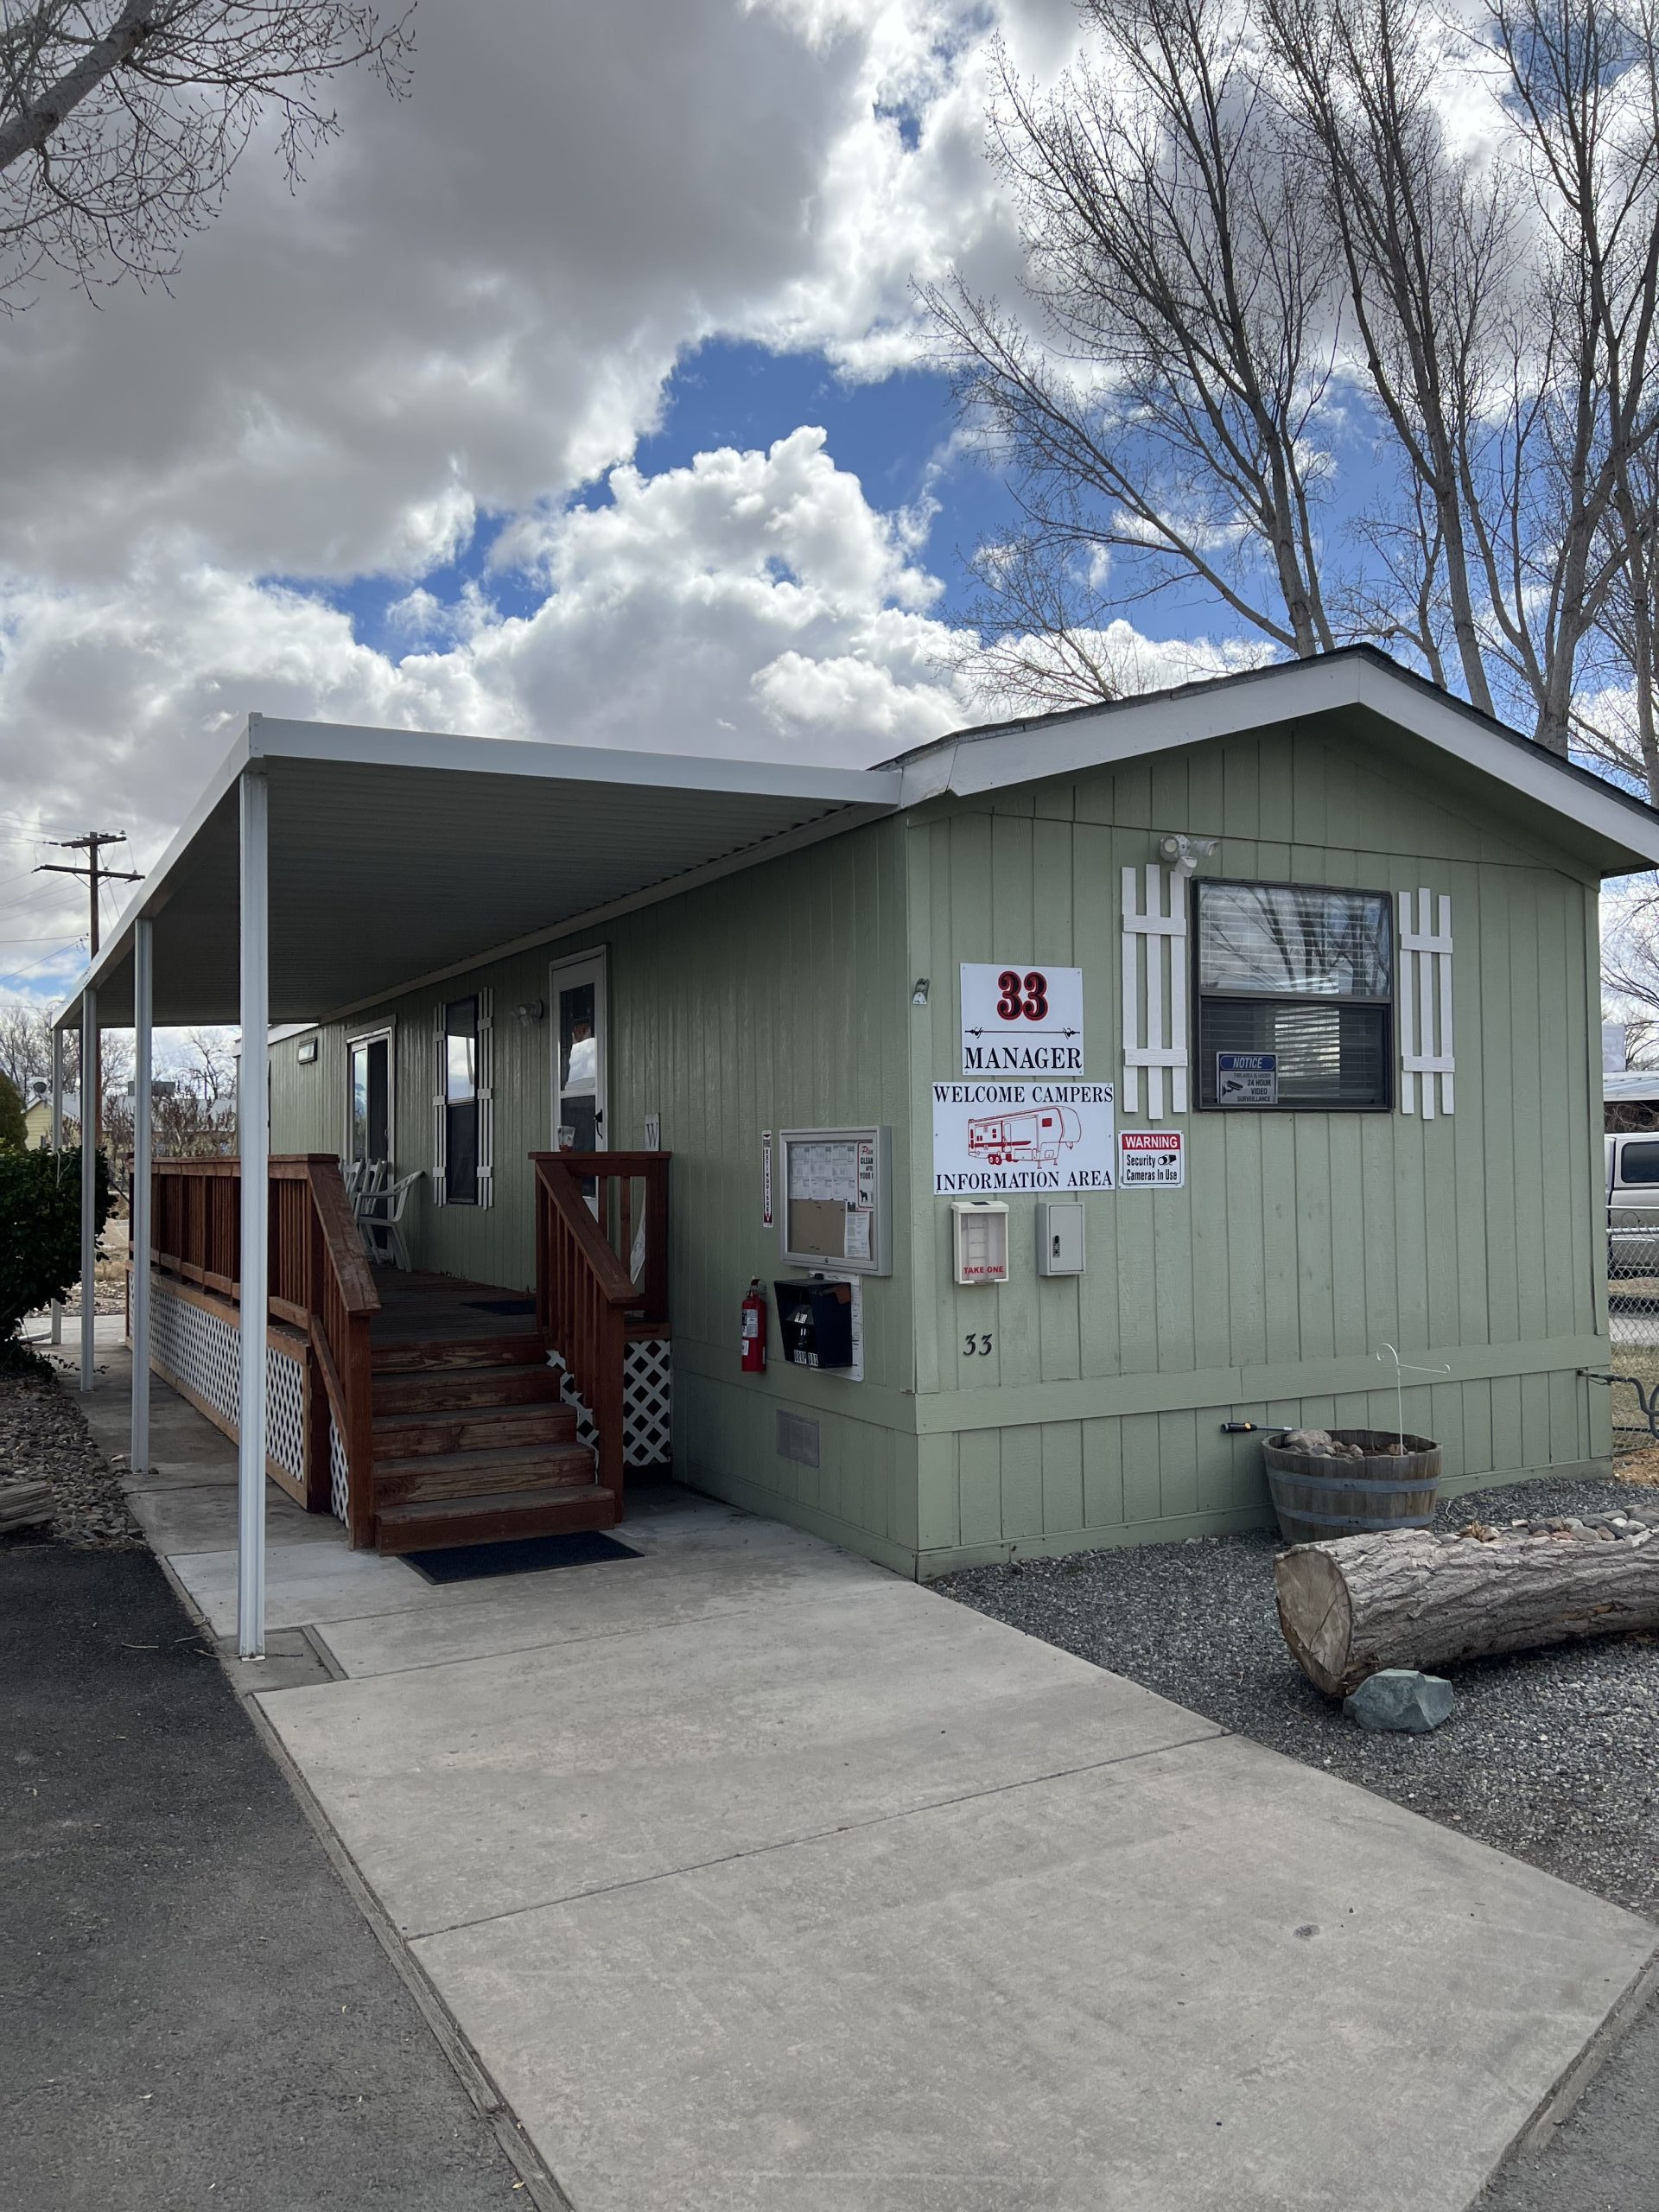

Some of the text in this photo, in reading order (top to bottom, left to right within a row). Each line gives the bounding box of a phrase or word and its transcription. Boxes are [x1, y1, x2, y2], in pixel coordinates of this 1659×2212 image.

[997, 970, 1048, 1021] 33
[964, 1046, 1083, 1070] MANAGER
[1232, 1057, 1263, 1069] NOTICE
[933, 1085, 1114, 1103] WELCOME CAMPERS
[1250, 1087, 1268, 1096] VIDEO
[1125, 1136, 1178, 1148] WARNING
[1126, 1154, 1156, 1168] Security
[935, 1170, 1113, 1191] INFORMATION AREA
[1126, 1168, 1178, 1181] Cameras In Use
[963, 1265, 1004, 1274] TAKE ONE
[963, 1332, 993, 1357] 33
